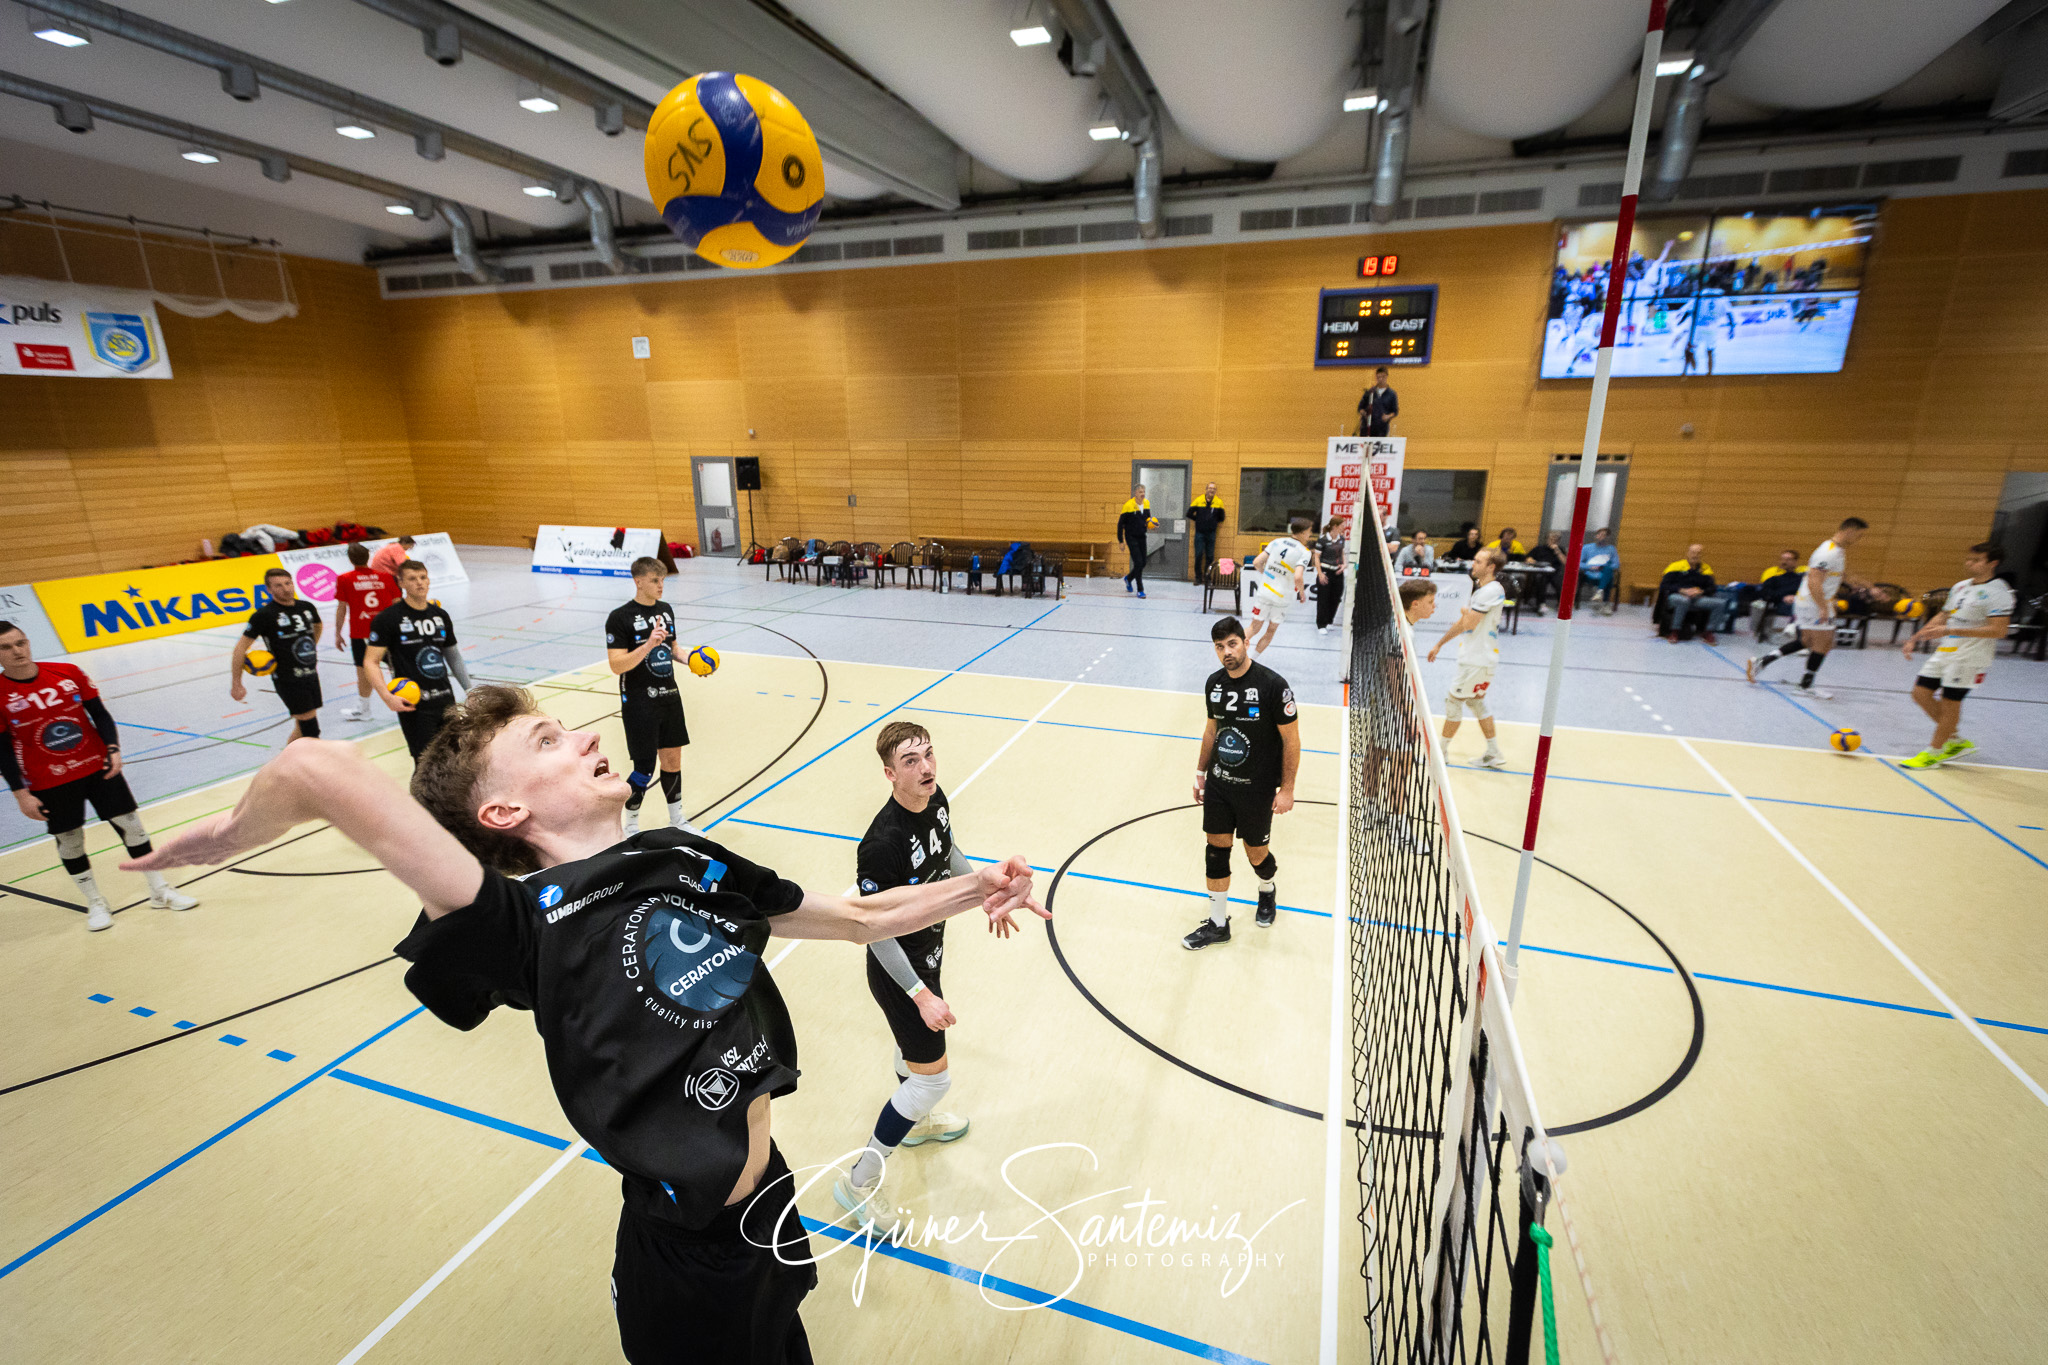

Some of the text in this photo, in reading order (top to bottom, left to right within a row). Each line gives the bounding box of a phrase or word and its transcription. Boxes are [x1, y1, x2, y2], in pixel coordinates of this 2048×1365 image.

[12, 302, 62, 325] puls
[1323, 318, 1427, 334] HEIM GAST
[1279, 548, 1289, 559] 4
[81, 584, 275, 638] MIKASA
[364, 591, 380, 608] 6
[414, 619, 436, 636] 10
[26, 687, 64, 710] 12
[1226, 691, 1239, 712] 2
[929, 827, 943, 856] 4
[545, 881, 624, 924] UMBRAGROUP
[622, 892, 739, 979] CERATONIA VOLLEYS
[645, 997, 688, 1029] quality
[720, 1046, 742, 1067] VSL
